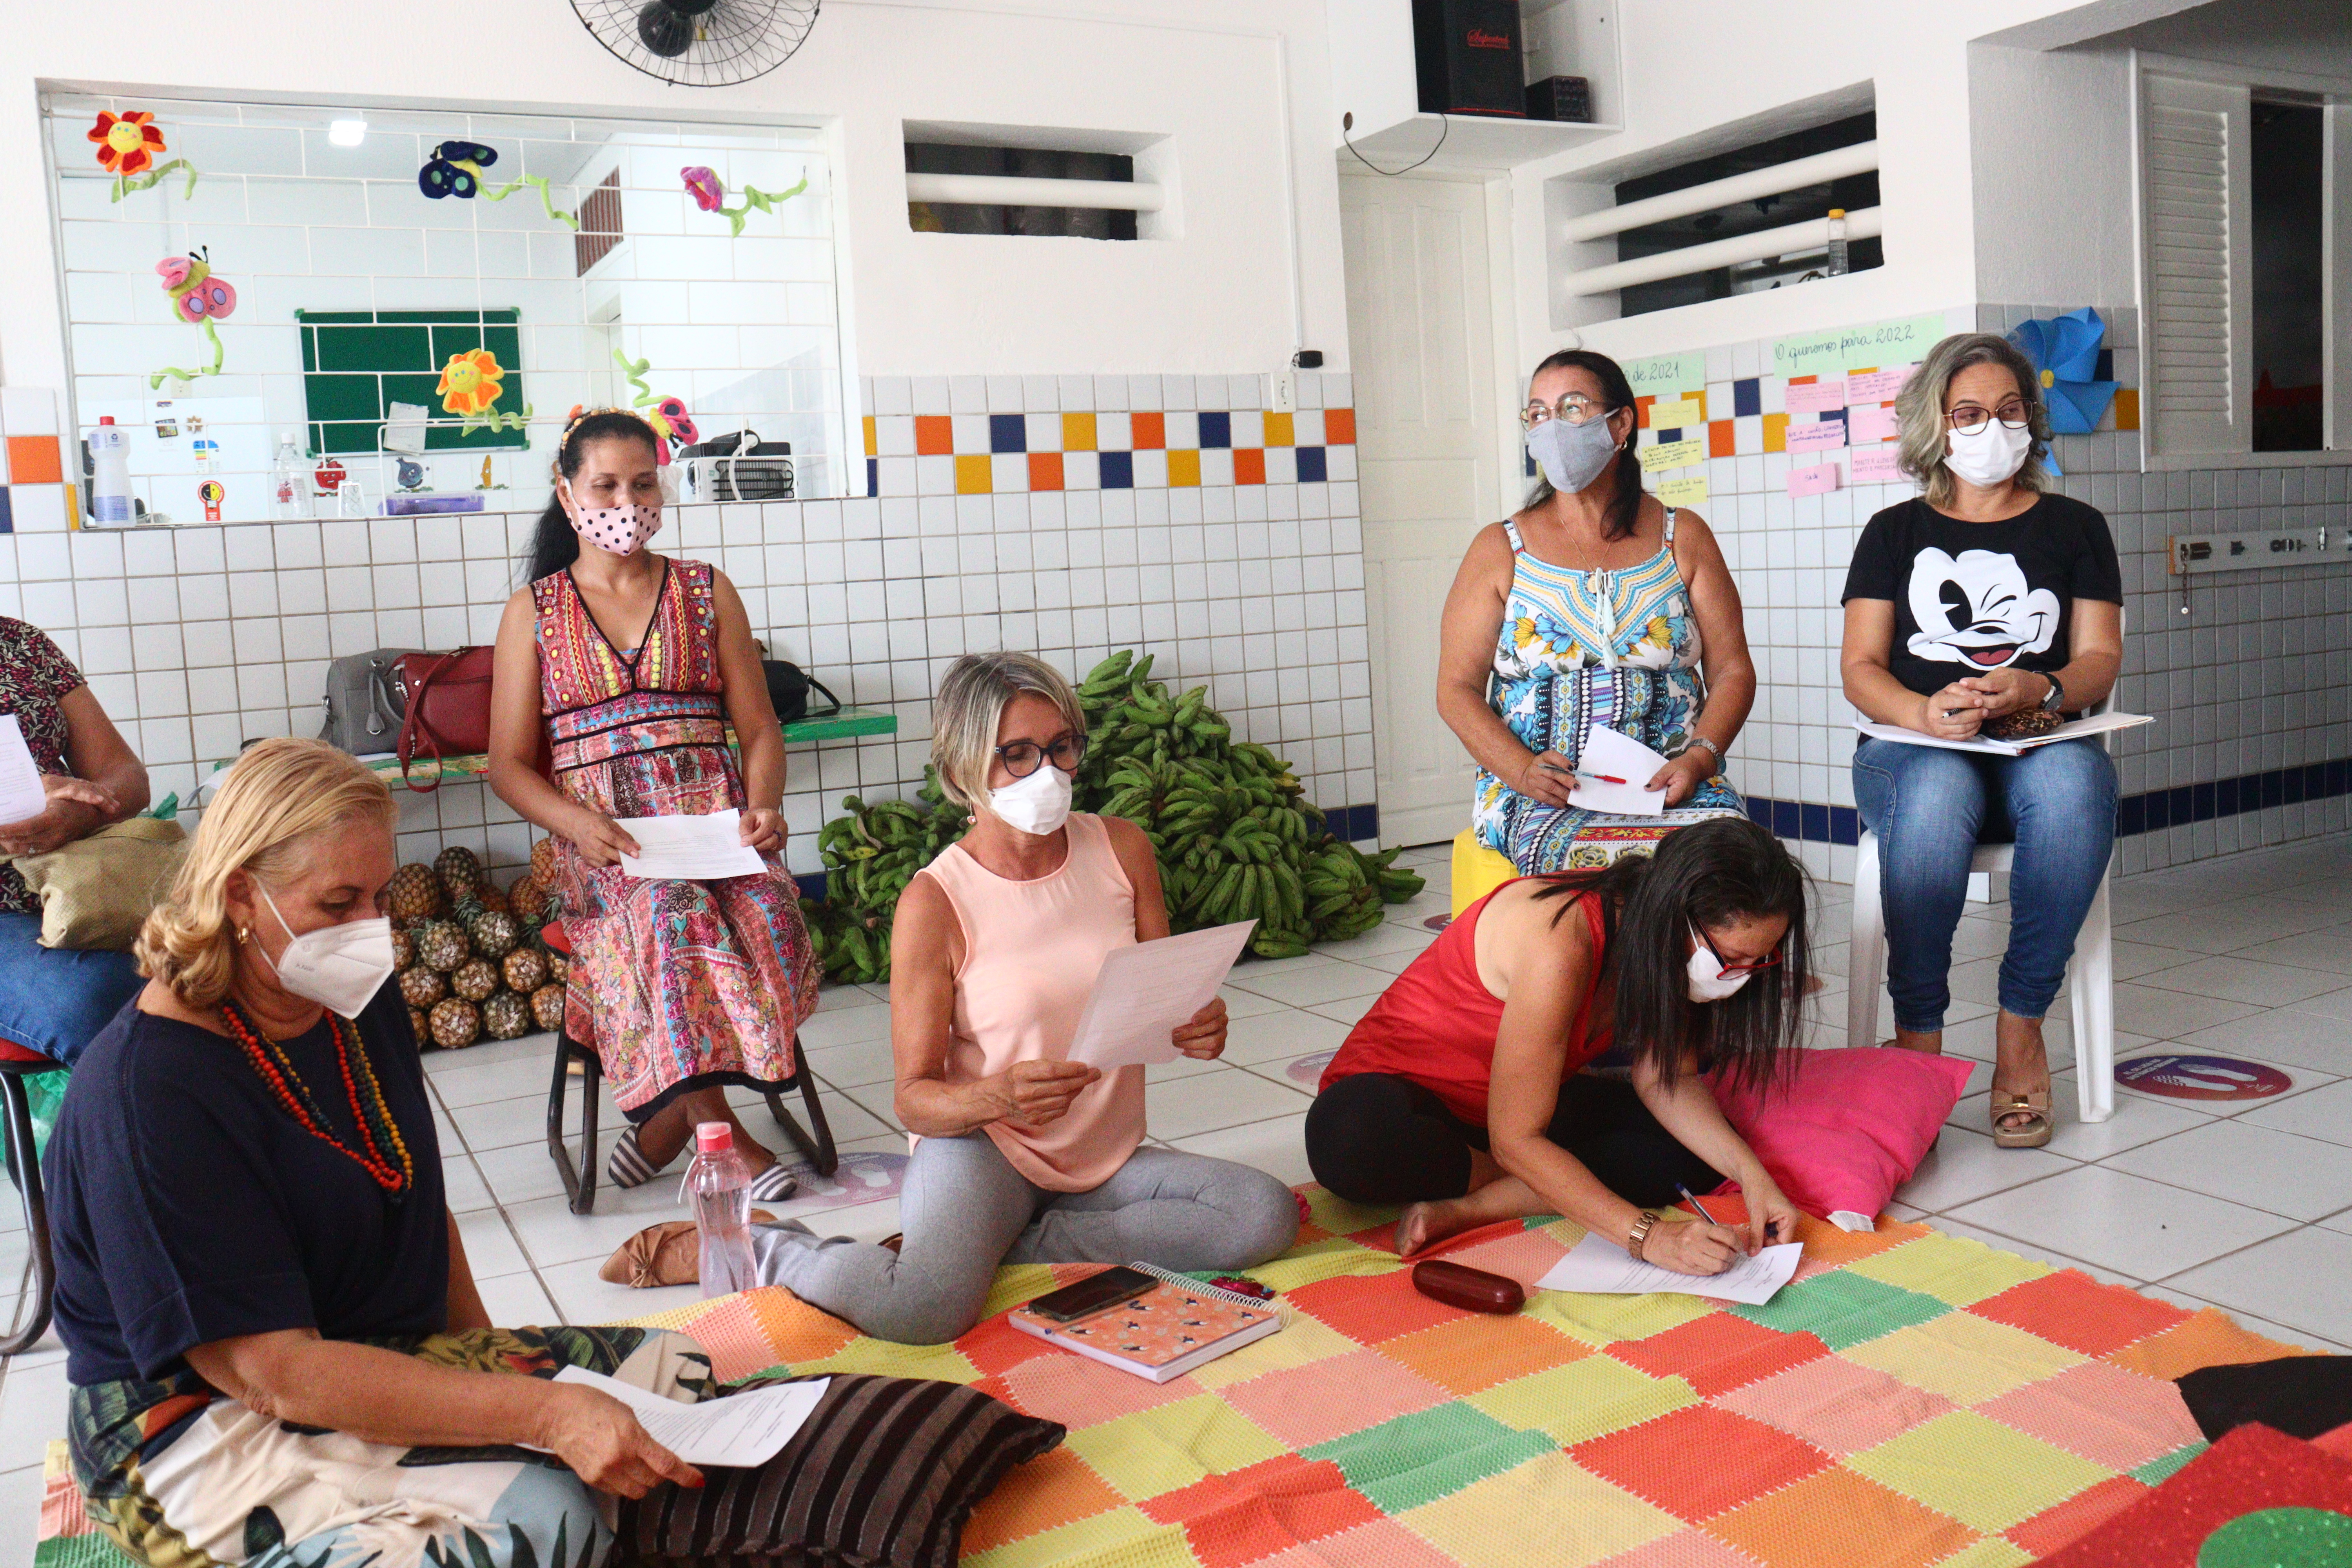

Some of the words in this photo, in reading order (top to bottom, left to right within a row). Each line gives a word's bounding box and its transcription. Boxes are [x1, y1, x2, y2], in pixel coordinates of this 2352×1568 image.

[1775, 343, 1785, 360] O
[1789, 341, 1837, 368] queremos
[1840, 336, 1872, 359] para
[1876, 325, 1915, 343] 2022
[1633, 364, 1646, 382] de
[1650, 361, 1679, 380] 2021
